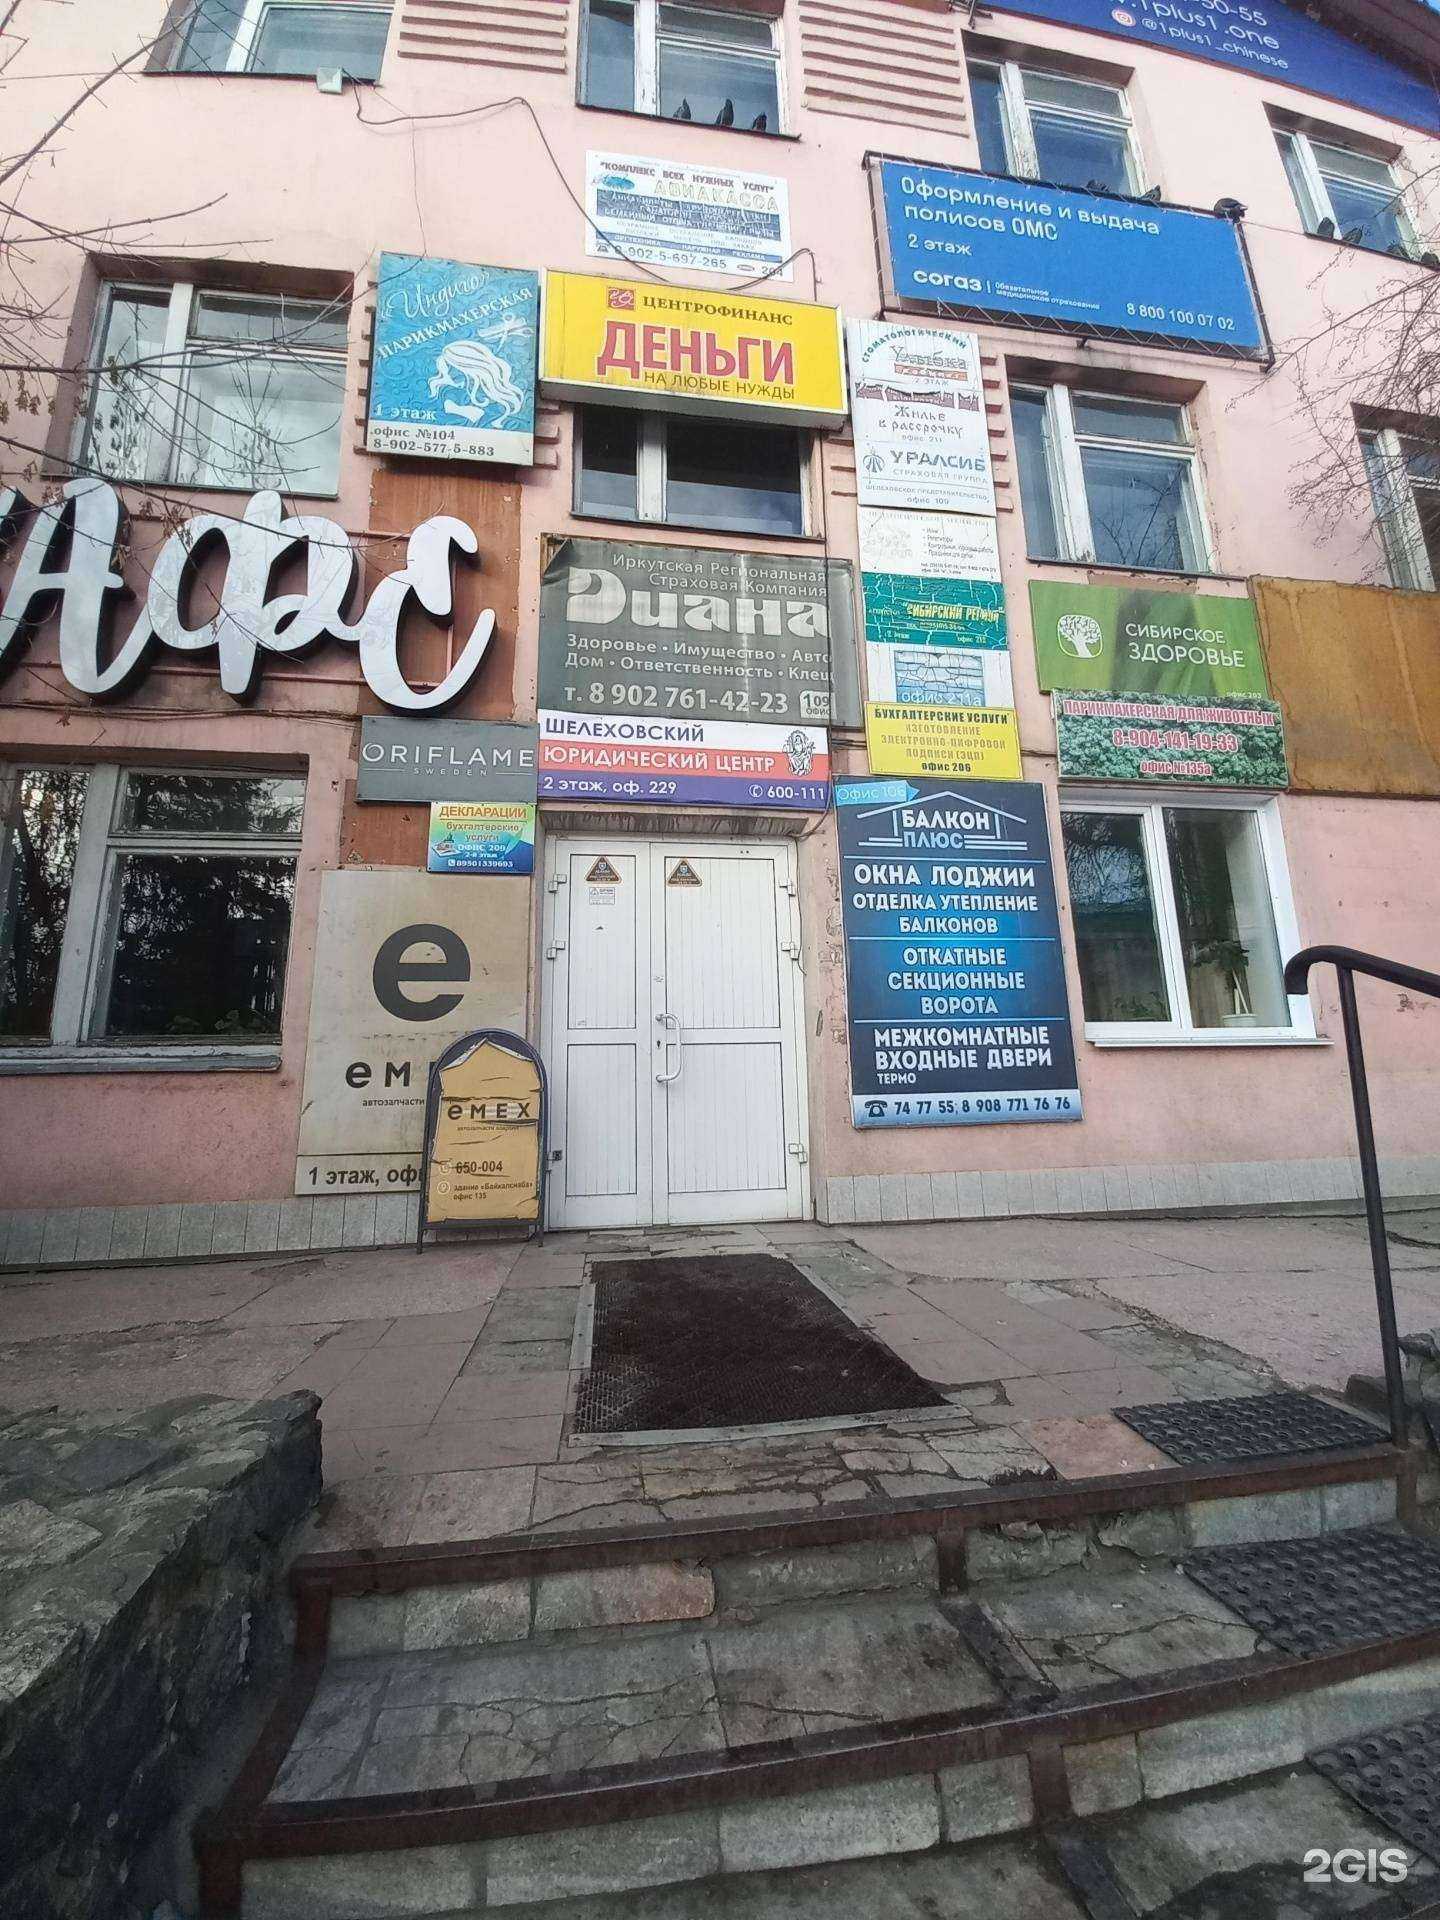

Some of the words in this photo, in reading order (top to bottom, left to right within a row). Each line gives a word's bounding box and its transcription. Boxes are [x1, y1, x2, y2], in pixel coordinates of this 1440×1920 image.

[663, 170, 684, 181] ВСЕХ
[692, 174, 734, 188] НУЖНЫХ
[654, 180, 779, 211] АВИАКАССА
[901, 176, 1052, 217] Оформление
[1058, 205, 1071, 220] и
[1078, 210, 1160, 236] выдача
[904, 205, 1006, 233] полисов
[1011, 217, 1059, 241] ОМС
[907, 234, 919, 248] 2
[923, 238, 973, 257] этаж
[912, 270, 983, 293] согаз
[643, 295, 793, 326] ЦЕНТРОФИНАНС
[1126, 302, 1136, 315] 8
[1139, 304, 1165, 320] 800
[1168, 309, 1194, 325] 100
[1197, 313, 1214, 327] 07
[1217, 317, 1236, 331] 02
[377, 288, 533, 360] ПАРИКМАХЕРСКАЯ
[597, 320, 794, 385] ДЕНЬГИ
[644, 371, 666, 386] НА
[672, 374, 730, 393] ЛЮБЫЕ
[736, 382, 795, 400] НУЖДЫ
[374, 403, 383, 416] 1
[390, 407, 437, 420] этаж
[374, 426, 410, 438] офис
[415, 428, 456, 440] №104
[373, 439, 495, 457] 8-902-577-5-883
[890, 450, 986, 471] УРАЛСИБ
[892, 468, 949, 479] СТРАХОВАЯ
[613, 553, 703, 574] Иркутская
[710, 562, 828, 582] Региональная
[650, 572, 738, 593] Страховая
[745, 578, 828, 597] Компания
[1125, 623, 1226, 644] СИБИРСКОЕ
[567, 634, 657, 653] Здоровье
[674, 642, 775, 662] Имущество
[1128, 642, 1246, 668] ЗДОРОВЬЕ
[565, 654, 604, 670] Дом
[620, 657, 773, 679] Ответственность
[564, 686, 582, 702] т.
[589, 683, 605, 703] 8
[611, 683, 658, 707] 902
[664, 686, 788, 714] 761-42-23
[804, 694, 830, 709] 109
[874, 708, 965, 722] БУХГАЛТЕРСКИЕ
[1064, 701, 1176, 720] ПАРИКМАХЕРСКАЯ
[1176, 706, 1205, 723] ДЛЯ
[1205, 709, 1275, 726] ЖИВОТНЫХ
[545, 717, 704, 743] ШЕЛЕХОВСКИЙ
[905, 723, 981, 736] ИЗГОТОВЛЕНИЕ
[1113, 729, 1239, 752] 8-904-141-19-33
[362, 743, 534, 767] ORIFLAME
[544, 745, 708, 770] ЮРИДИЧЕСКИЙ
[716, 754, 774, 774] ЦЕНТР
[906, 748, 955, 760] ПОДПИСИ
[956, 750, 985, 761] (ЭЦП)
[413, 767, 488, 776] SWEDEN
[921, 763, 950, 772] офис
[952, 763, 971, 772] 206
[1141, 761, 1172, 774] офис
[1173, 762, 1212, 775] №135а
[543, 777, 554, 790] 2
[558, 778, 607, 793] этаж,
[612, 779, 645, 795] оф.
[649, 780, 677, 794] 229
[767, 786, 825, 801] 600-111
[439, 806, 527, 819] ДЕКЛАРАЦИИ
[901, 809, 990, 830] БАЛКОН
[446, 821, 519, 832] бухгалтерские
[466, 834, 499, 842] услуги
[903, 831, 964, 849] ПЛЮС
[854, 864, 921, 885] ОКНА
[930, 865, 1035, 888] ЛОДЖИИ
[852, 893, 936, 911] ОТДЕЛКА
[940, 894, 1038, 912] УТЕПЛЕНИЕ
[899, 916, 998, 933] БАЛКОНОВ
[903, 947, 1007, 966] ОТКАТНЫЕ
[887, 971, 1026, 991] СЕКЦИОННЫЕ
[921, 996, 999, 1016] ВОРОТА
[874, 1026, 1050, 1047] МЕЖКОМНАТНЫЕ
[875, 1049, 978, 1071] ВХОДНЫЕ
[987, 1048, 1053, 1070] ДВЕРИ
[877, 1072, 917, 1085] ТЕРМО
[362, 1099, 425, 1107] автозапчасти
[894, 1101, 911, 1115] 74
[916, 1101, 931, 1114] 77
[938, 1101, 958, 1115] 55;
[962, 1100, 970, 1113] 8
[977, 1099, 1001, 1113] 908
[1007, 1098, 1029, 1112] 771
[1034, 1098, 1050, 1111] 76
[1054, 1097, 1071, 1110] 76
[309, 1167, 318, 1185] 1
[326, 1169, 380, 1186] этаж,
[456, 1161, 503, 1174] 650-004
[453, 1184, 479, 1192] здание
[453, 1193, 472, 1201] офис
